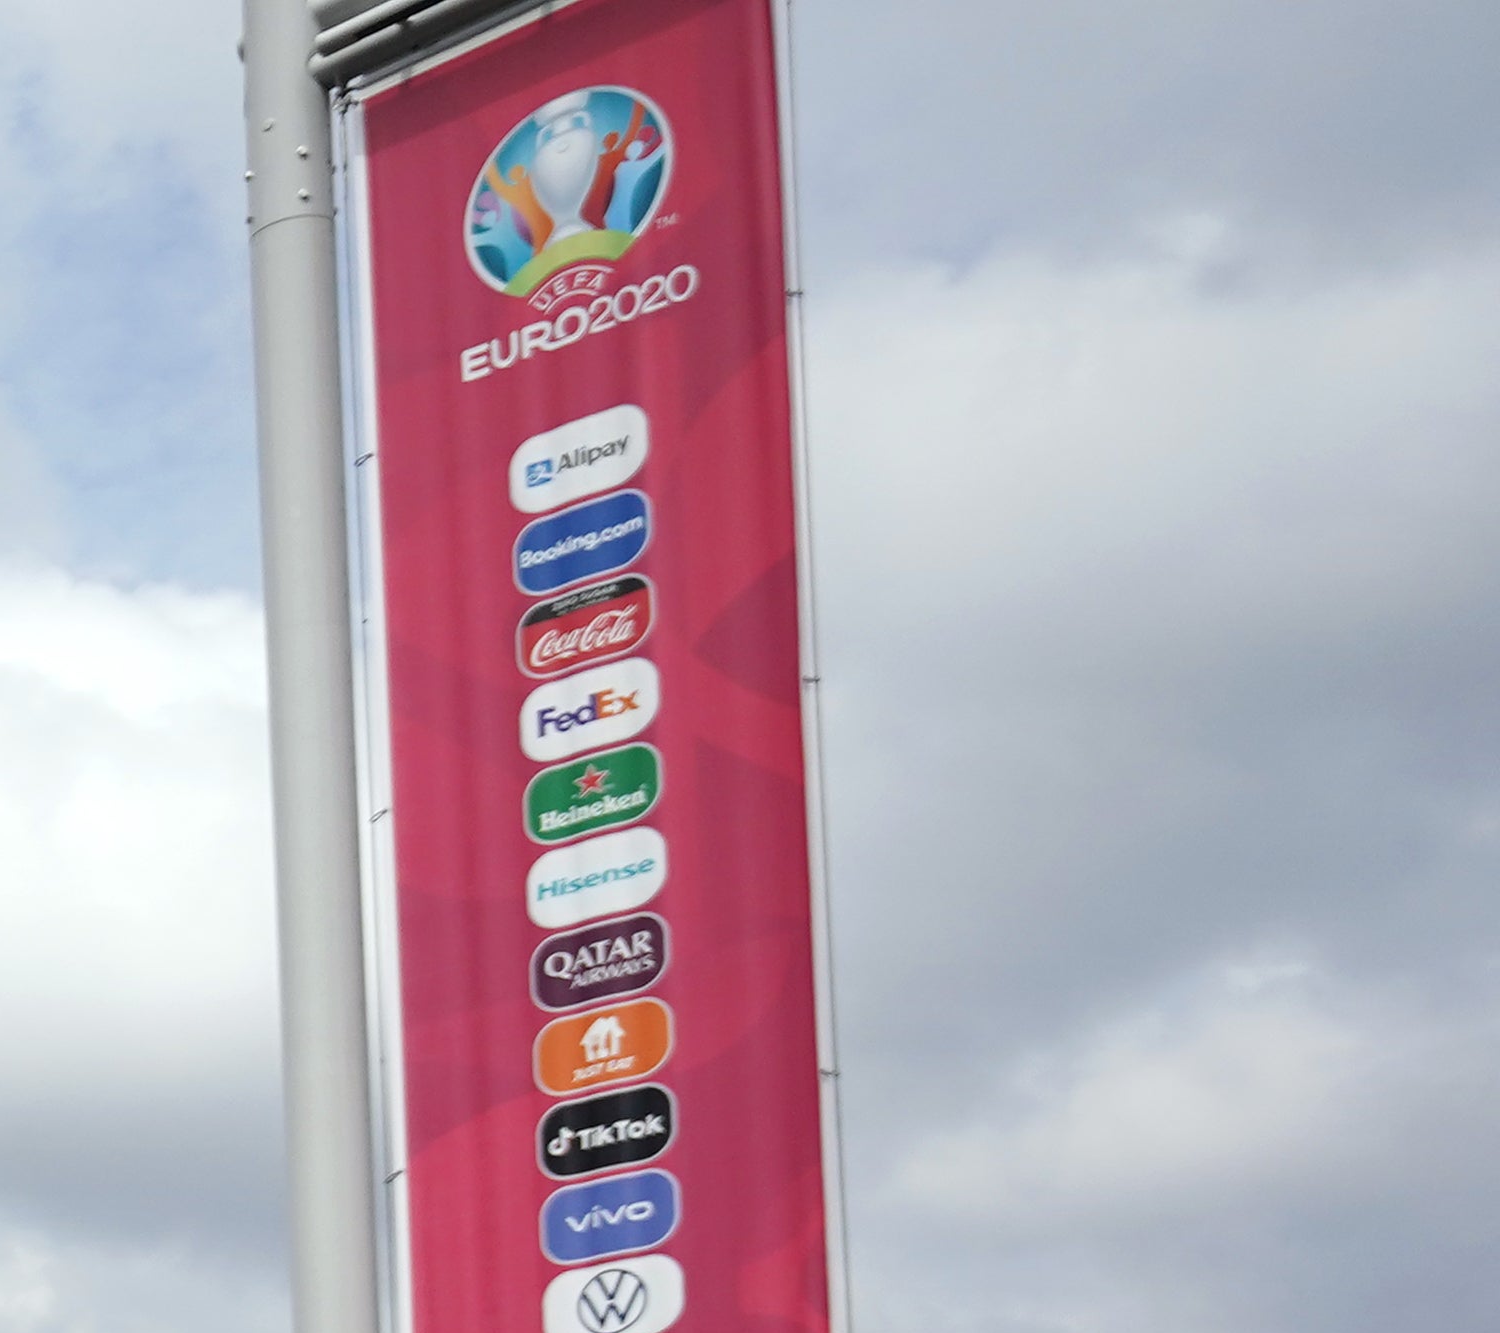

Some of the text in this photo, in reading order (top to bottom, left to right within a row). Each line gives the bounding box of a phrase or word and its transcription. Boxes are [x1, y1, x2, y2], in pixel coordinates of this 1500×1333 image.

[534, 270, 605, 311] UEFA
[461, 264, 698, 382] EURO2020
[557, 435, 630, 473] Alipay
[519, 516, 645, 568] Booking.com
[537, 688, 640, 738] FedEx
[539, 788, 649, 832] Heineken
[537, 858, 655, 900] Hisense
[544, 930, 652, 979] QATAR
[569, 955, 655, 988] AIRWAYS
[580, 1114, 665, 1150] TikTok
[565, 1201, 654, 1232] vivo
